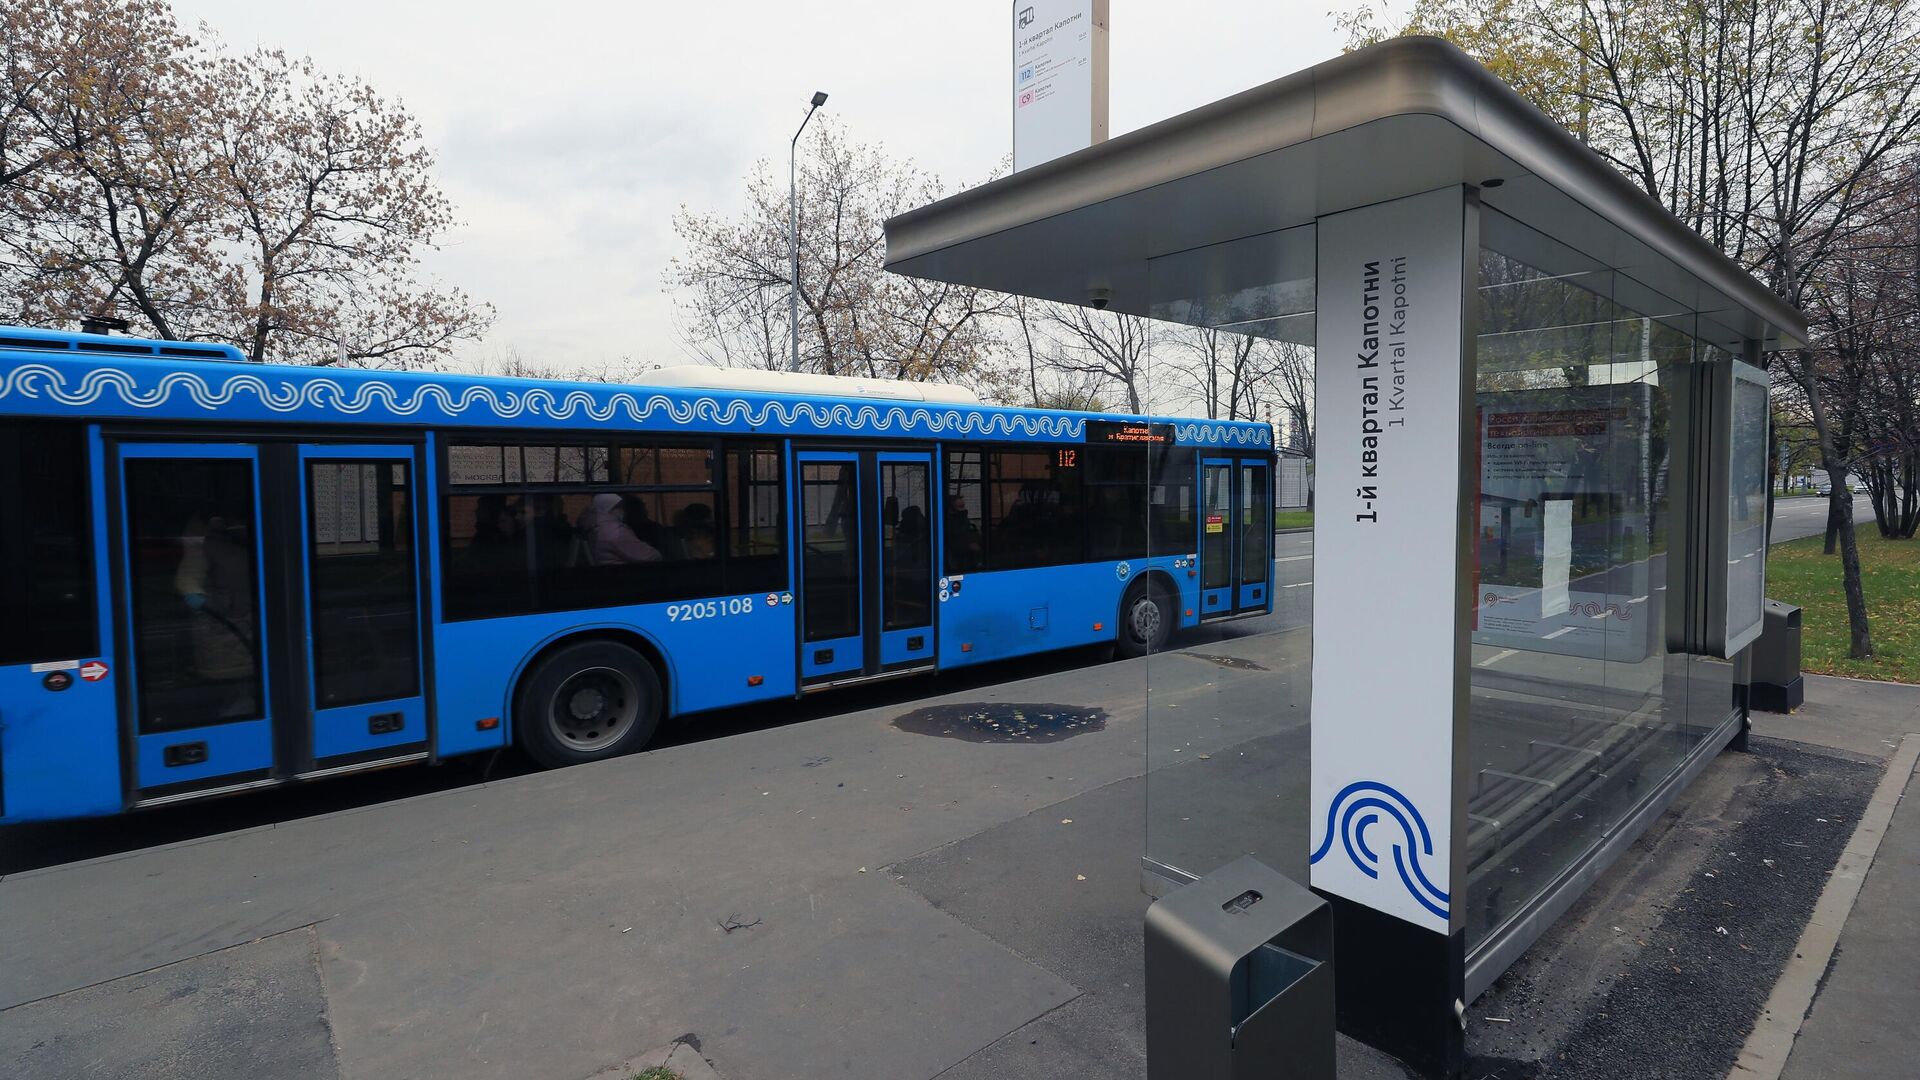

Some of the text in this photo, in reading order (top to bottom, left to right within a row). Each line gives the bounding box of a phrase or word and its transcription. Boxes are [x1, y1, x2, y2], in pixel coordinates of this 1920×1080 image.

[1028, 26, 1054, 44] квартал
[1054, 12, 1082, 31] Капотни
[1021, 69, 1031, 81] 112
[1389, 256, 1410, 427] 1 Kvartal Kapotni
[1356, 261, 1383, 523] 1-й квартал Капотни
[1487, 440, 1549, 450] Всегда on-line
[1058, 449, 1077, 468] 112
[666, 598, 753, 623] 9205108
